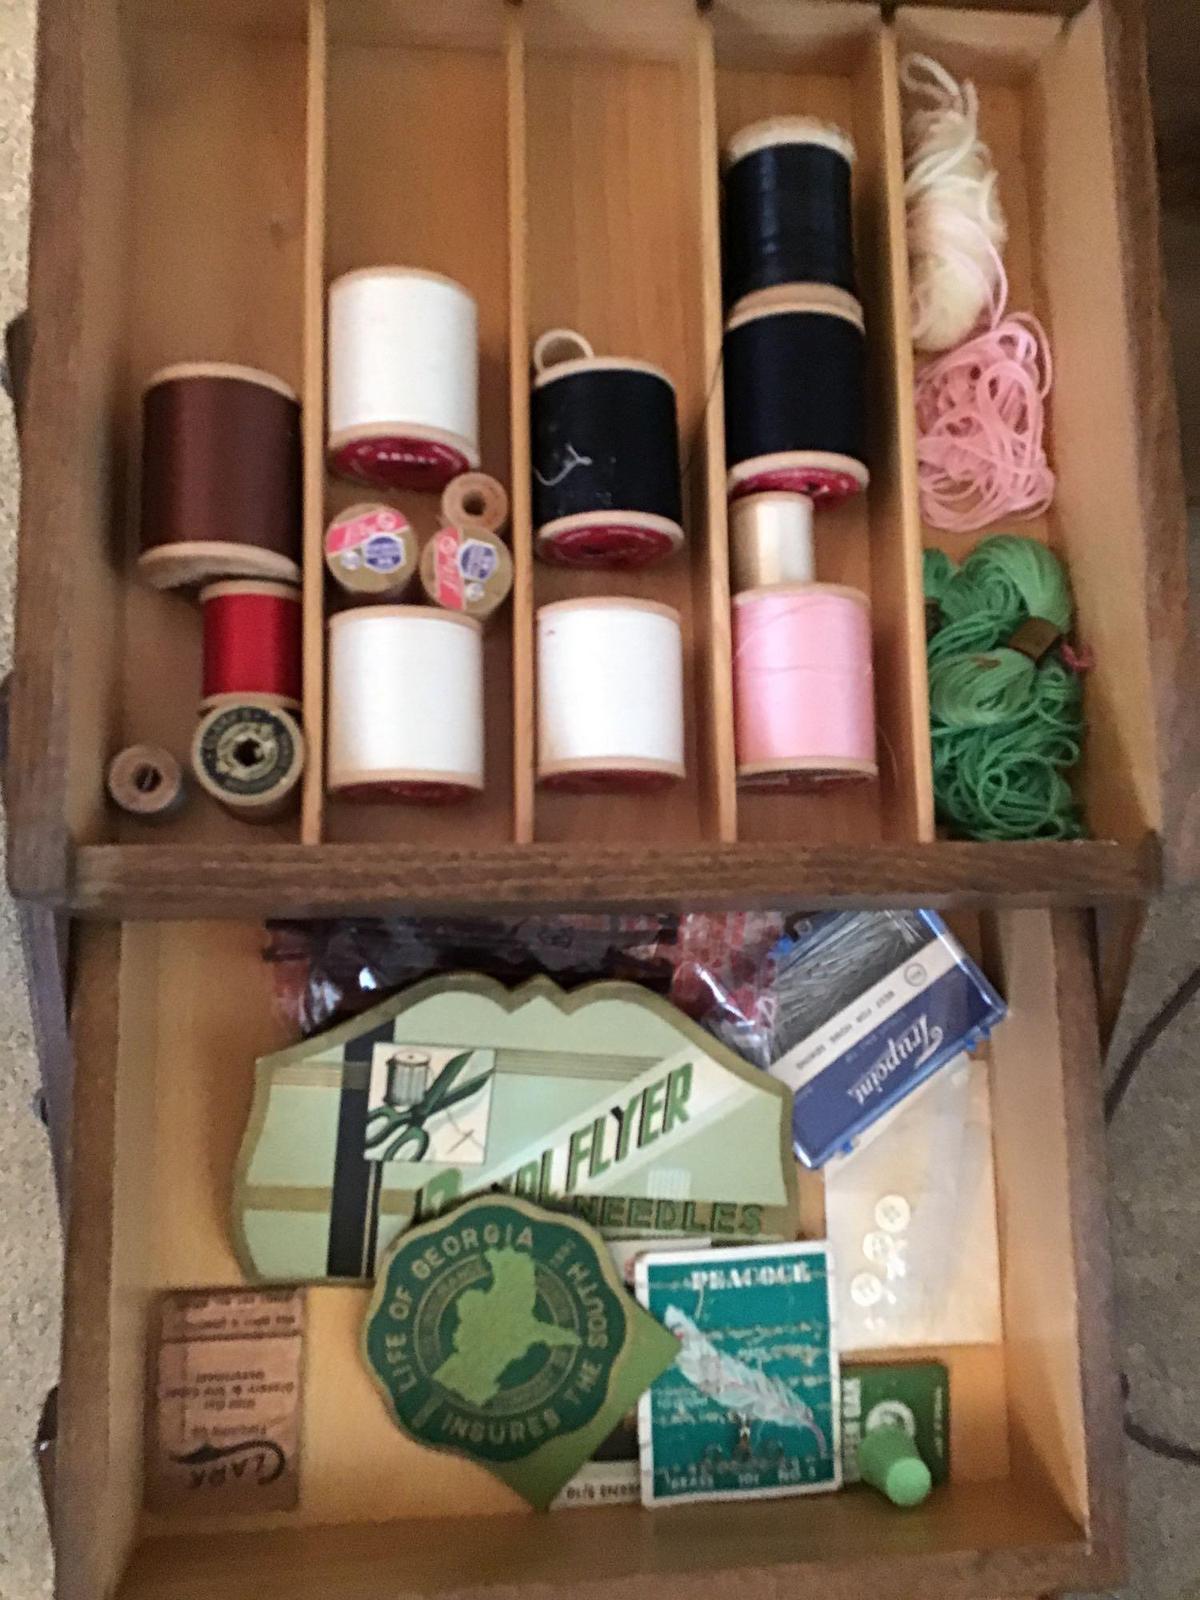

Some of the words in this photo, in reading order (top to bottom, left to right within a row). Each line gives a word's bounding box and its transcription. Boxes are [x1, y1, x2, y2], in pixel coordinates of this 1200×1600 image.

[847, 1013, 943, 1105] Trupoint
[565, 1062, 694, 1194] FLYER
[576, 1195, 764, 1236] NEEDLES
[411, 1223, 533, 1280] GEORGIA
[689, 1258, 813, 1292] PEACOCK
[388, 1284, 413, 1321] OF
[566, 1261, 609, 1350] SOUTH
[385, 1333, 418, 1393] LIFE
[563, 1358, 602, 1405] THE
